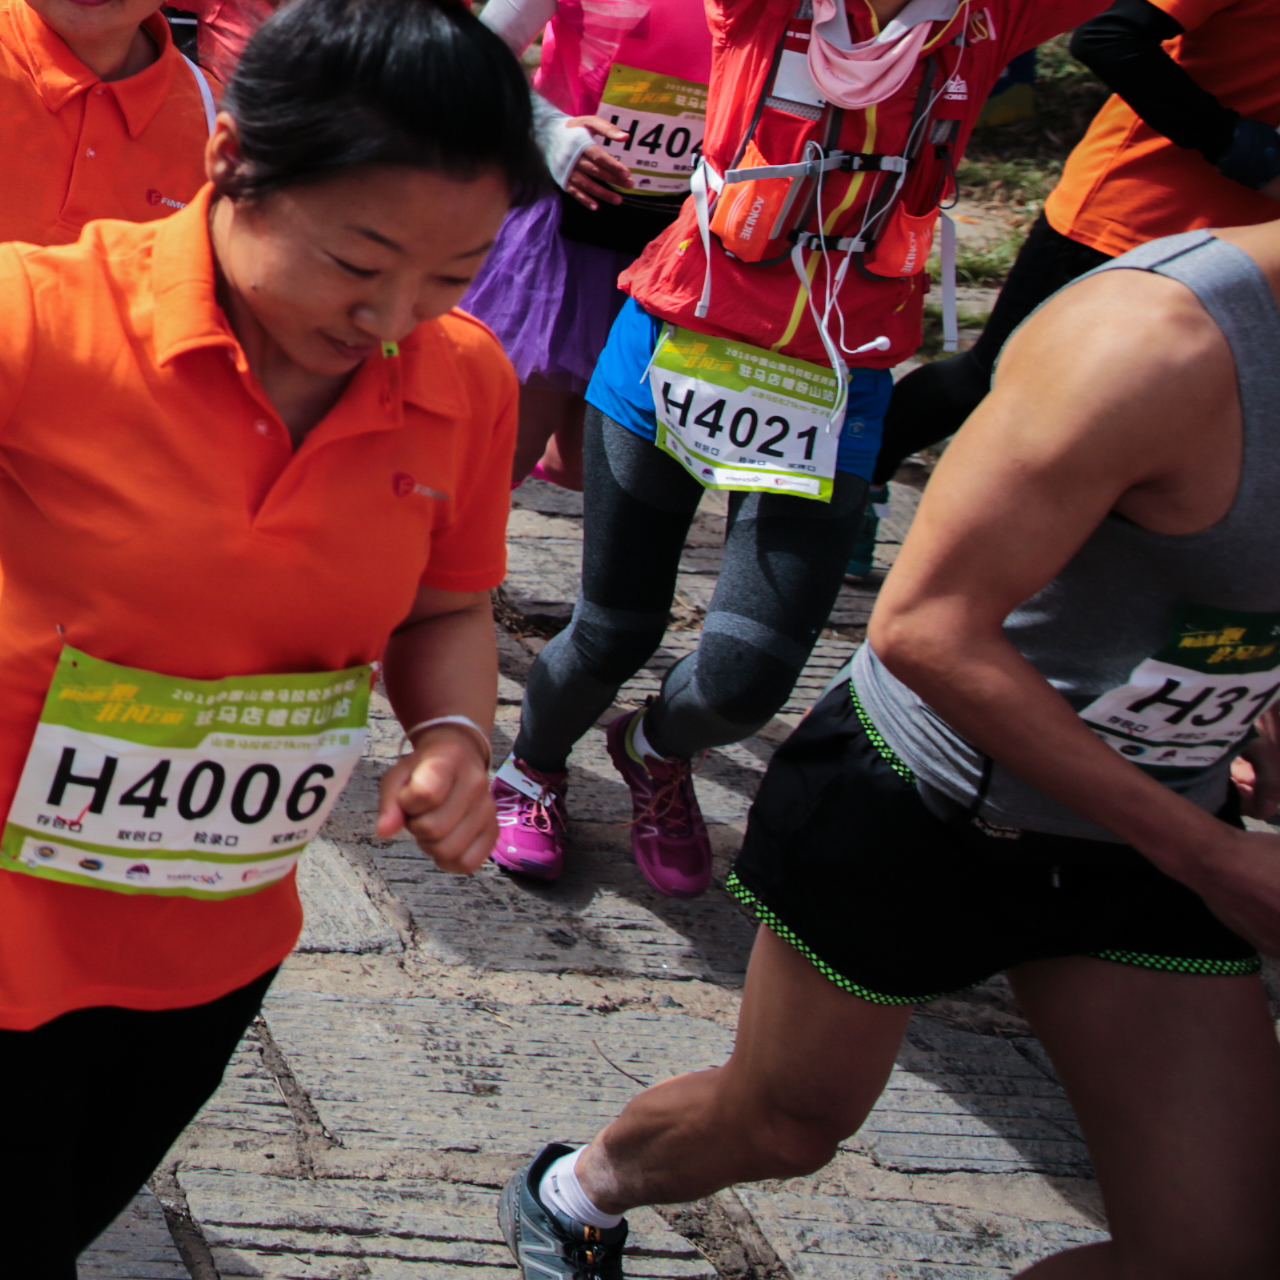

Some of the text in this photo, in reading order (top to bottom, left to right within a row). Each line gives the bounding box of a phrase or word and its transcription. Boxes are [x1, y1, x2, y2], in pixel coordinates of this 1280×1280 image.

[662, 380, 819, 461] H4021
[46, 746, 336, 825] H4006
[116, 829, 163, 844] 取包口
[194, 831, 239, 847] 检录口
